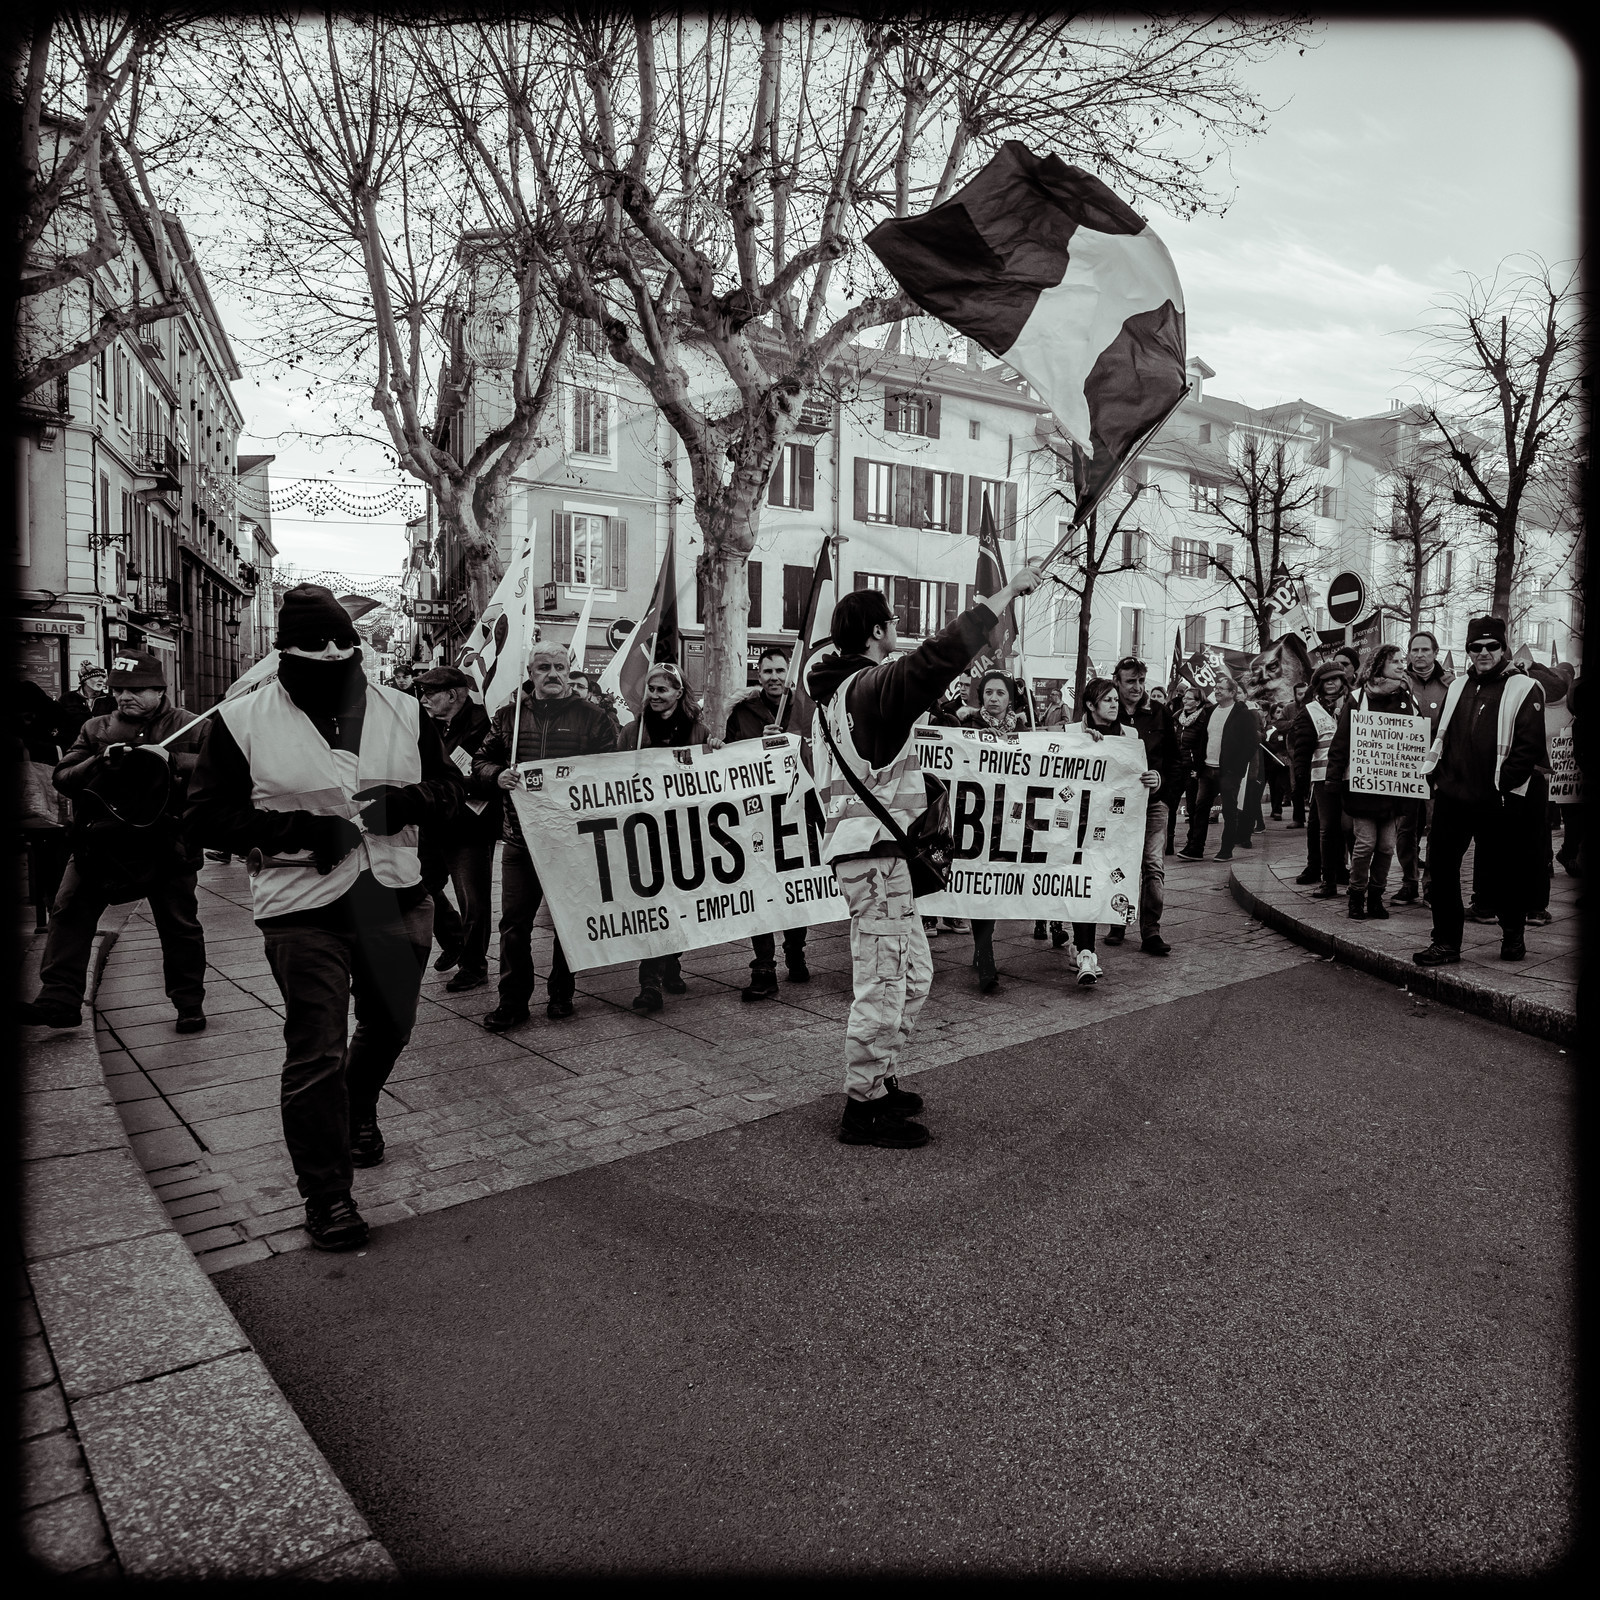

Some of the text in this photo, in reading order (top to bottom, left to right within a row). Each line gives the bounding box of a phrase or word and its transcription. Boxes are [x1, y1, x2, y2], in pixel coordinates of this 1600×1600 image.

[545, 588, 556, 600] DH
[415, 603, 450, 614] DH
[35, 623, 82, 634] GLACES
[1352, 714, 1414, 728] NOUS SOMMES
[981, 734, 994, 742] FO
[1356, 727, 1367, 737] LA
[1409, 733, 1425, 742] DES
[1357, 749, 1367, 757] DE
[979, 748, 1031, 776] PRIVÉS
[1039, 754, 1107, 782] D'EMPLOI
[1356, 757, 1370, 765] DES
[1366, 765, 1398, 777] L'HEURE
[1401, 771, 1411, 779] DE
[526, 773, 544, 786] cgt
[569, 773, 655, 811] SALARIÉS
[746, 797, 760, 811] FO
[577, 802, 746, 903] TOUS
[1032, 873, 1092, 898] SOCIALE
[586, 905, 670, 941] SALAIRES
[696, 890, 755, 923] EMPLOI
[785, 875, 844, 905] SERVIC
